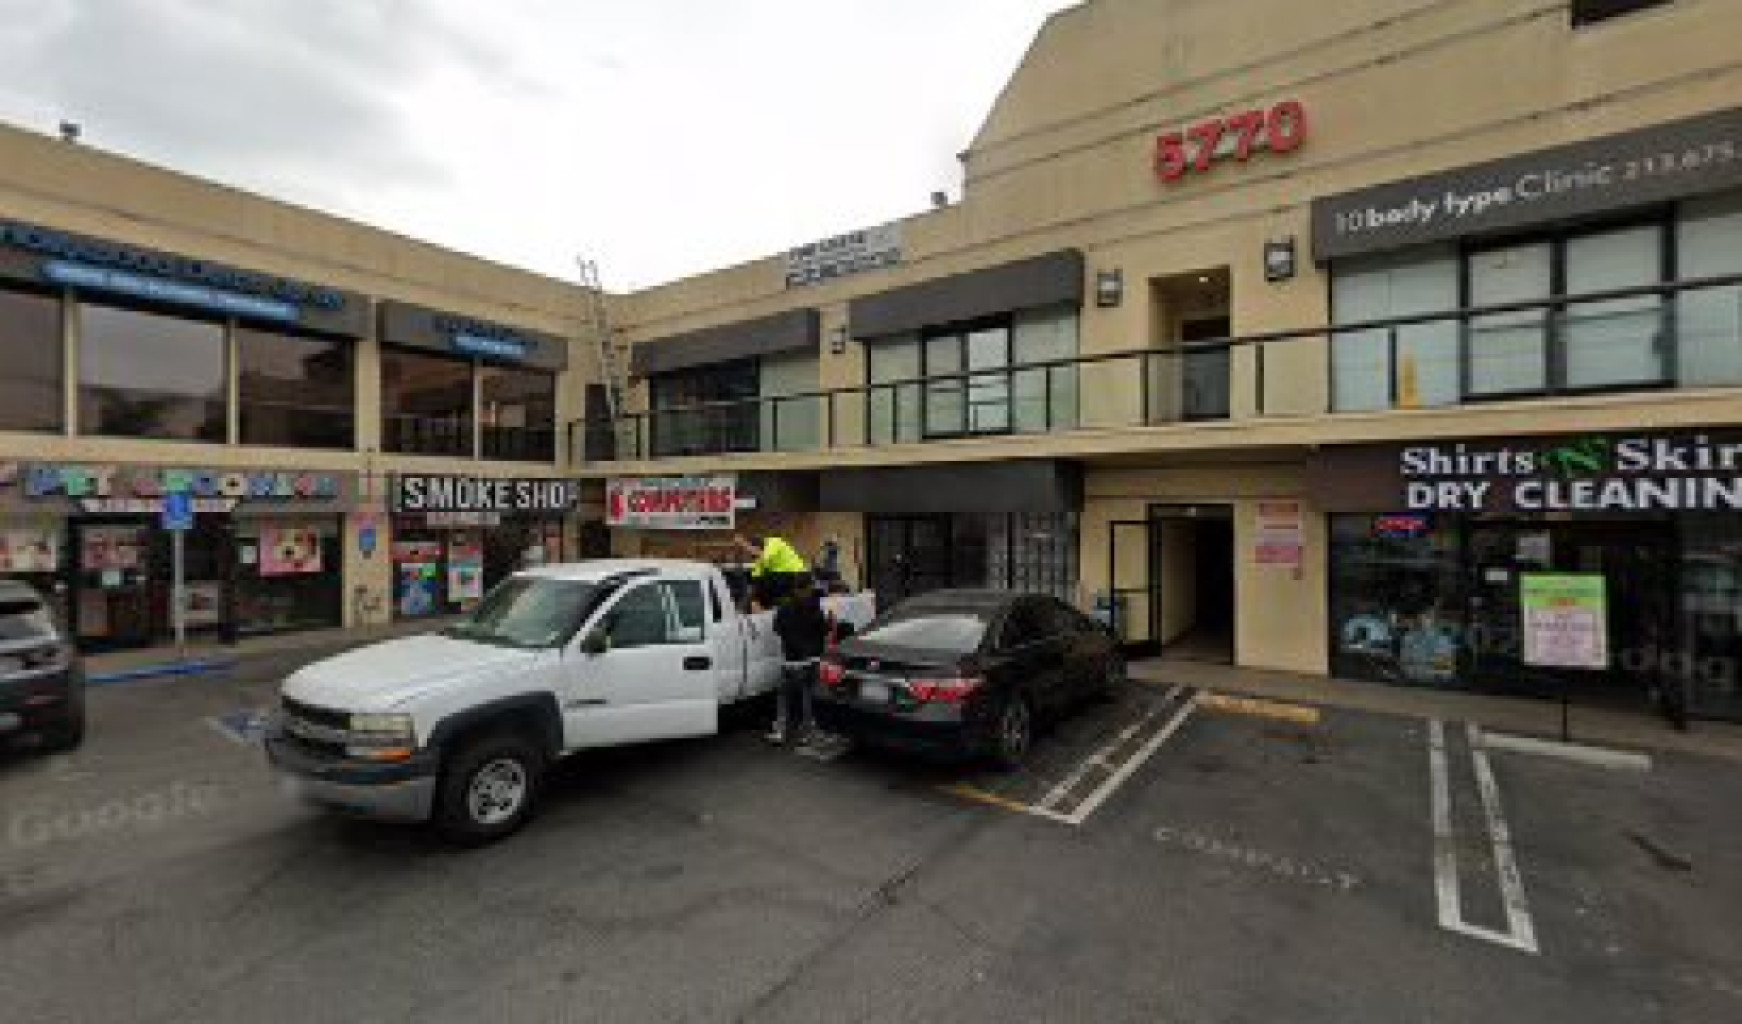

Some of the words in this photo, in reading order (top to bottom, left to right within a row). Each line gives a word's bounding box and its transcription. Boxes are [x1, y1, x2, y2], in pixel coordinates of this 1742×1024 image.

[1156, 101, 1307, 183] 5770
[1515, 161, 1612, 197] Clinic
[1401, 444, 1535, 475] Shirts
[404, 477, 511, 509] SMOKE
[1407, 481, 1490, 509] DRY
[1514, 477, 1742, 509] CLEANIN
